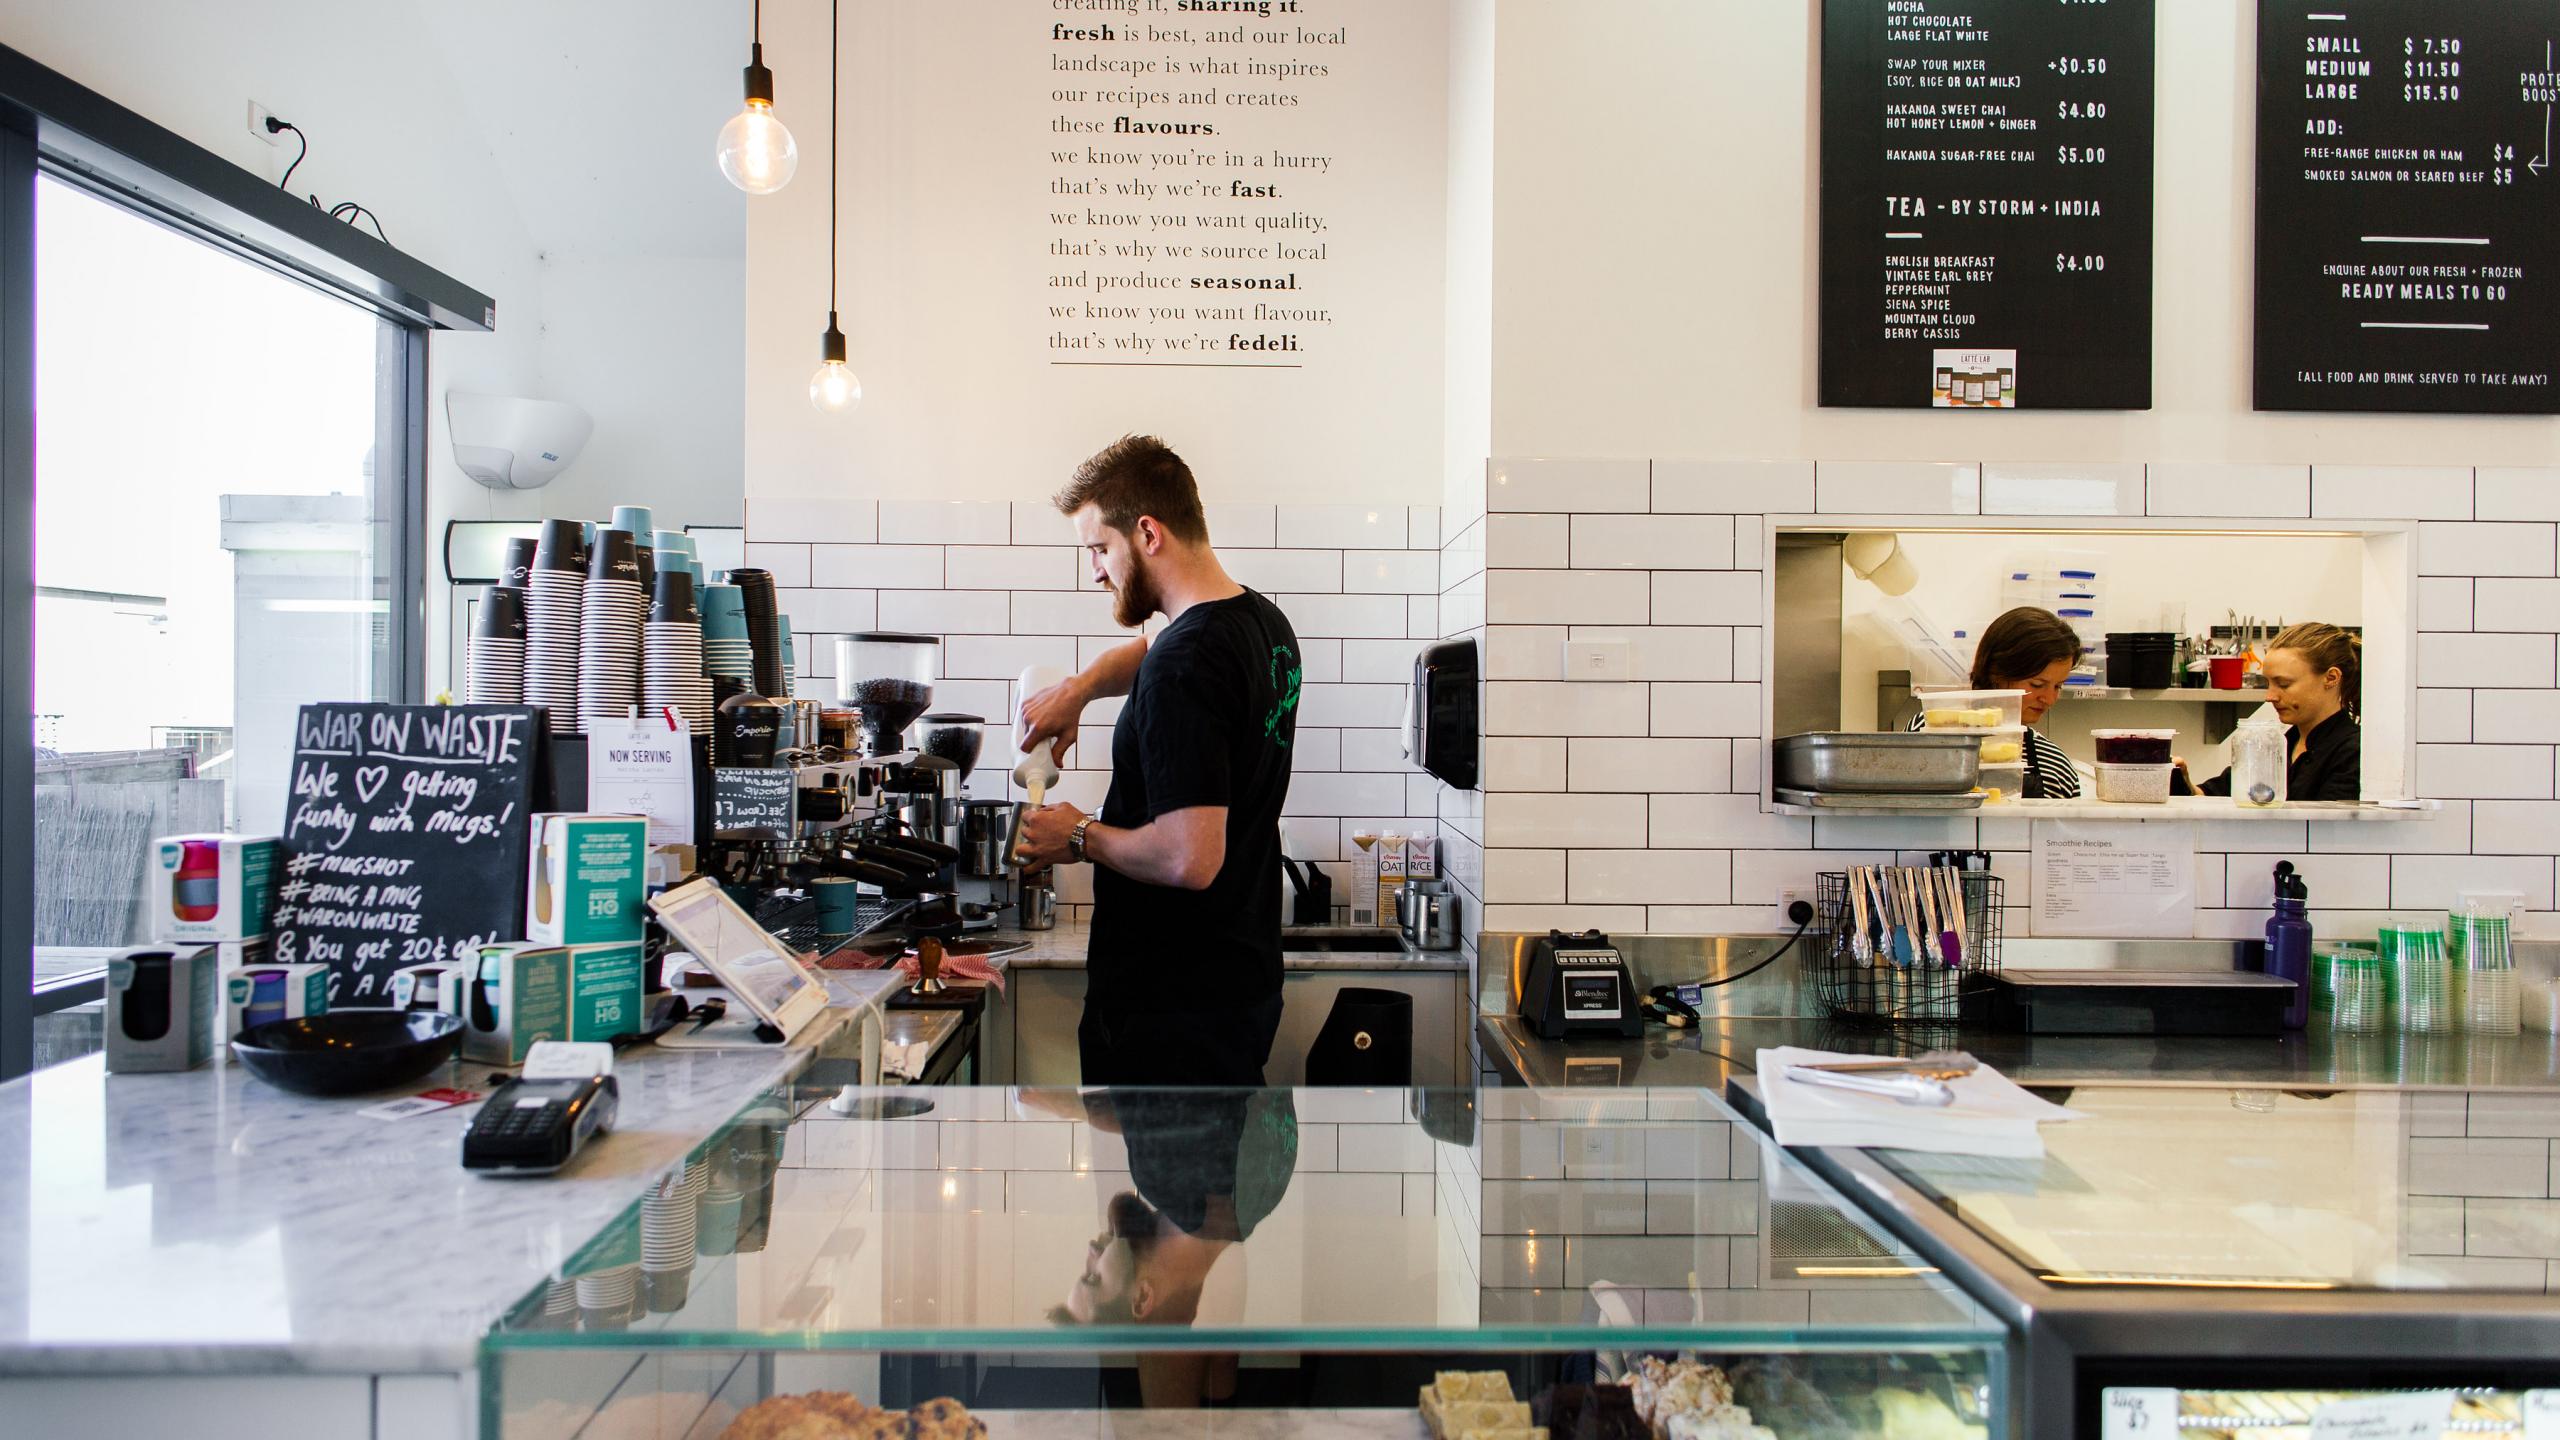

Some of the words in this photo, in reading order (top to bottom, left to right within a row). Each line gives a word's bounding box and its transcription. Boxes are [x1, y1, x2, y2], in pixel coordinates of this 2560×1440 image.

[1888, 1, 1924, 12] MOCHA
[1888, 16, 1907, 26] HOT
[1913, 16, 1972, 27] CHOCOLATE
[1052, 22, 1116, 41] fresh
[1124, 23, 1139, 42] is
[1148, 24, 1196, 45] best,
[1205, 25, 1244, 43] and
[1252, 32, 1289, 44] our
[1297, 26, 1345, 45] local
[1888, 30, 1920, 41] LARGE
[1926, 30, 1951, 41] FLAT
[1956, 31, 1988, 41] WHITE
[2307, 37, 2360, 53] SMALL
[1052, 53, 1156, 78] landscape
[1166, 55, 1181, 73] is
[1189, 56, 1239, 75] what
[1247, 57, 1329, 81] inspires
[1888, 59, 1916, 69] SWAP
[1922, 60, 1948, 70] YOUR
[1953, 60, 1985, 71] MIXER
[2306, 60, 2369, 76] MEDIUM
[1920, 76, 1943, 87] RICE
[1948, 76, 1960, 87] OR
[1966, 76, 1985, 87] OAT
[1051, 90, 1088, 102] our
[1096, 85, 1170, 109] recipes
[1178, 87, 1217, 105] and
[1225, 92, 1298, 107] creates
[2306, 84, 2357, 99] LARGE
[2404, 84, 2458, 102] $15.50
[1887, 104, 1936, 115] HAKANOA
[1941, 105, 1976, 115] SWEET
[1982, 105, 2005, 116] CHAI
[2059, 101, 2105, 119] $4.80
[1052, 115, 1105, 133] these
[1113, 116, 1220, 136] flavours.
[1887, 118, 1905, 128] HOT
[1912, 119, 1945, 129] HONEY
[1950, 119, 1984, 129] LEMON
[2000, 119, 2036, 130] GINGER
[2306, 120, 2342, 135] ADD:
[1051, 151, 1078, 164] we
[1087, 146, 1143, 165] know
[1151, 148, 1216, 171] you're
[1225, 150, 1244, 167] in
[1274, 150, 1332, 174] hurry
[1887, 150, 1935, 160] HAKANOA
[1941, 150, 2005, 161] SUGAR-FREE
[2011, 151, 2034, 161] CHAI
[2059, 146, 2104, 164] $5.00
[2305, 148, 2368, 159] FREE-RANGE
[2375, 149, 2417, 159] CHICKEN
[2423, 150, 2435, 160] OR
[2441, 150, 2462, 161] HAM
[2494, 144, 2513, 161] $4
[2305, 170, 2344, 180] SMOKED
[2351, 171, 2392, 181] SALMON
[2397, 171, 2409, 181] OR
[2415, 171, 2454, 182] SEARED
[2459, 172, 2484, 182] BEEF
[2494, 167, 2512, 185] $5
[1051, 176, 1108, 195] that's
[1116, 178, 1158, 201] why
[1166, 179, 1222, 197] we're
[1230, 179, 1283, 198] fast.
[1886, 197, 1925, 217] TEA
[1952, 200, 1971, 214] BY
[1979, 200, 2033, 215] STORM
[2056, 200, 2100, 216] INDIA
[1050, 213, 1077, 225] we
[1087, 208, 1141, 226] know
[1150, 215, 1186, 232] you
[1196, 215, 1245, 228] want
[1254, 211, 1327, 234] quality,
[1050, 238, 1107, 256] that's
[1115, 239, 1157, 263] why
[1165, 246, 1193, 258] we
[1201, 246, 1268, 259] source
[1277, 242, 1326, 260] local
[1886, 256, 1928, 267] ENGLISH
[1934, 256, 1994, 267] BREAKFAST
[2057, 254, 2104, 272] $4.00
[2324, 265, 2365, 276] ENQUIRE
[2371, 265, 2404, 276] ABOUT
[2410, 266, 2429, 276] OUR
[2434, 266, 2466, 276] FRESH
[2482, 267, 2521, 278] FROZEN
[1049, 270, 1087, 288] and
[1096, 270, 1181, 294] produce
[1190, 273, 1302, 290] seasonal.
[1886, 270, 1930, 281] VINTAGE
[1935, 271, 1961, 281] EARL
[1967, 271, 1993, 281] GREY
[1886, 285, 1950, 295] PEPPERMINT
[2342, 284, 2393, 298] READY
[2401, 284, 2454, 300] MEALS
[2461, 285, 2479, 299] TO
[2487, 286, 2505, 300] GO
[1048, 306, 1076, 318] we
[1086, 300, 1140, 319] know
[1149, 307, 1185, 325] you
[1194, 307, 1243, 321] want
[1254, 303, 1332, 324] flavour,
[1886, 299, 1916, 309] SIENA
[1921, 299, 1950, 310] SPICE
[1885, 314, 1937, 325] MOUNTAIN
[1943, 314, 1975, 325] CLOUD
[1885, 328, 1918, 339] BERRY
[1923, 328, 1959, 338] CASSIS
[1049, 331, 1105, 349] that's
[1114, 332, 1156, 355] why
[1164, 332, 1219, 351] we're
[1228, 333, 1304, 352] fedeli.
[2328, 372, 2353, 383] FOOD
[2359, 373, 2378, 383] AND
[2385, 373, 2414, 383] DRINK
[2420, 373, 2458, 384] SERVED
[2464, 374, 2476, 383] TO
[2482, 374, 2506, 384] TAKE
[300, 710, 363, 756] WAR
[370, 712, 412, 753] ON
[421, 709, 528, 764] WASTE
[609, 750, 630, 763] NOW
[633, 750, 672, 763] SERVING
[295, 761, 339, 797] We
[2046, 840, 2082, 848] Smoothie
[2084, 840, 2112, 848] Recipes
[1381, 861, 1404, 872] OAT
[1410, 861, 1432, 871] RICE
[364, 887, 377, 906] A
[353, 938, 392, 972] get
